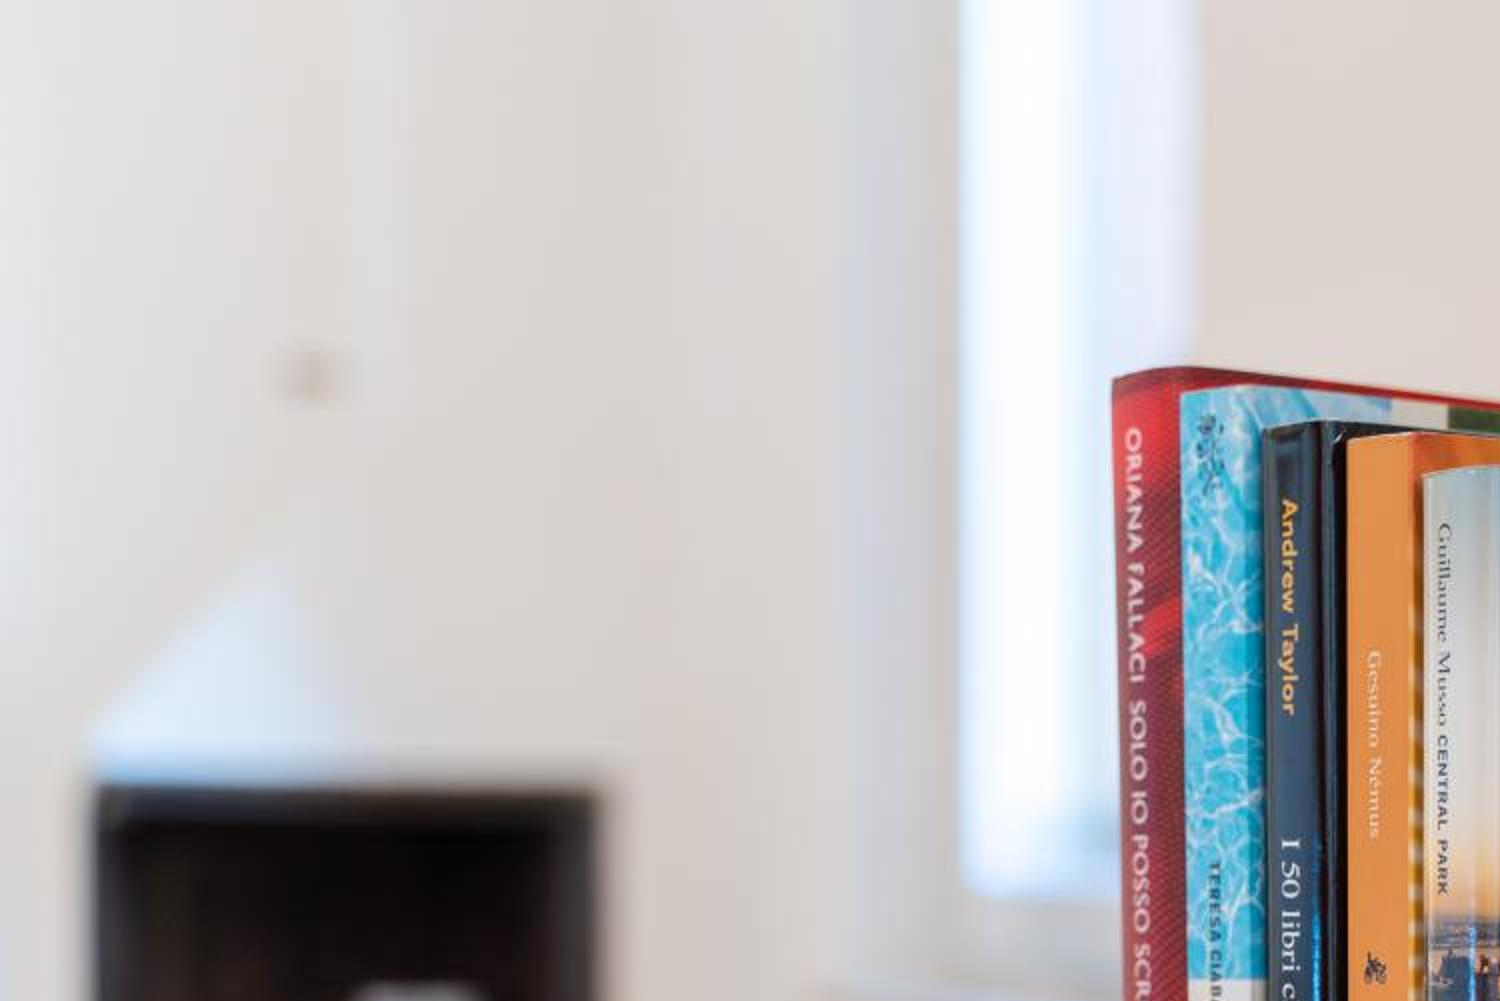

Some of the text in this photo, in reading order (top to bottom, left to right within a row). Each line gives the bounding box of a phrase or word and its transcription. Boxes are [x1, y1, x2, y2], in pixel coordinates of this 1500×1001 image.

[1124, 427, 1143, 553] ORIANA
[1127, 562, 1146, 682] FALLACI
[1279, 499, 1299, 715] Andrew Taylor
[1129, 700, 1148, 781] SOLO
[1367, 650, 1383, 748] Gesuino
[1436, 523, 1451, 895] Guillaume Musso CENTRAL PARK
[1131, 791, 1149, 825] IO
[1132, 834, 1151, 934] POSSO
[1207, 861, 1221, 941] TERESA
[1281, 862, 1300, 899] 50
[1281, 911, 1301, 971] libri
